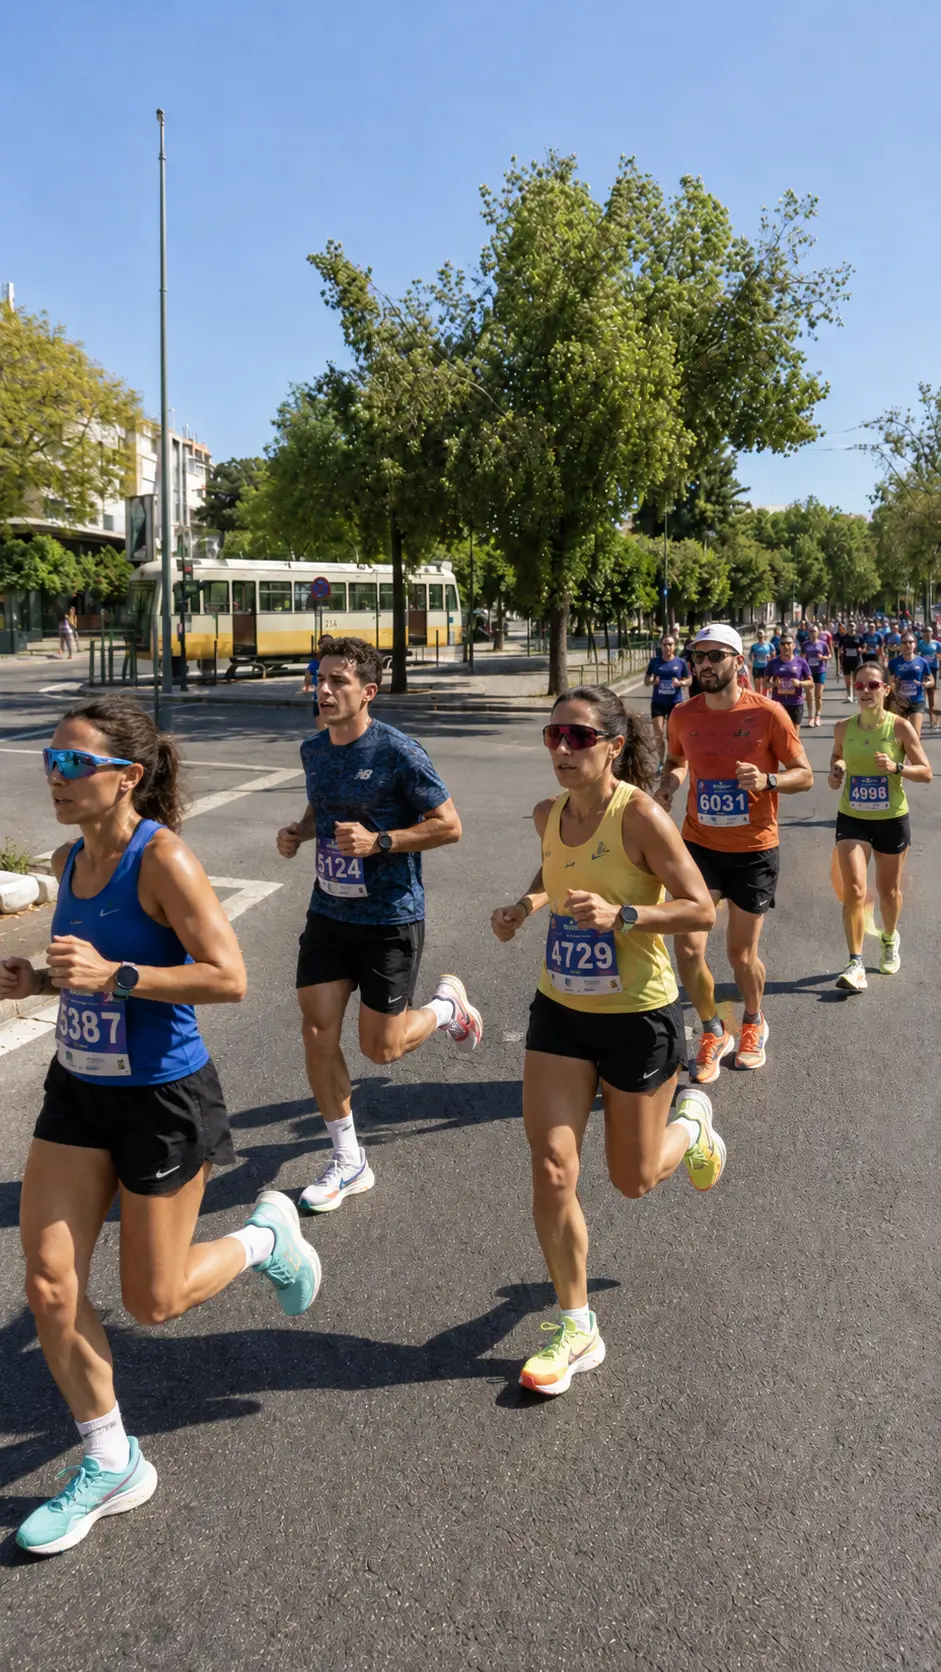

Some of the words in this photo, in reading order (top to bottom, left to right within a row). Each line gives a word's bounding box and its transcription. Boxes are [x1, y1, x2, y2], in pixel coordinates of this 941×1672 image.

[699, 793, 745, 812] 6031
[852, 786, 887, 800] 4998
[317, 853, 362, 879] 5124
[551, 940, 613, 970] 4729
[59, 1003, 121, 1044] 5387
